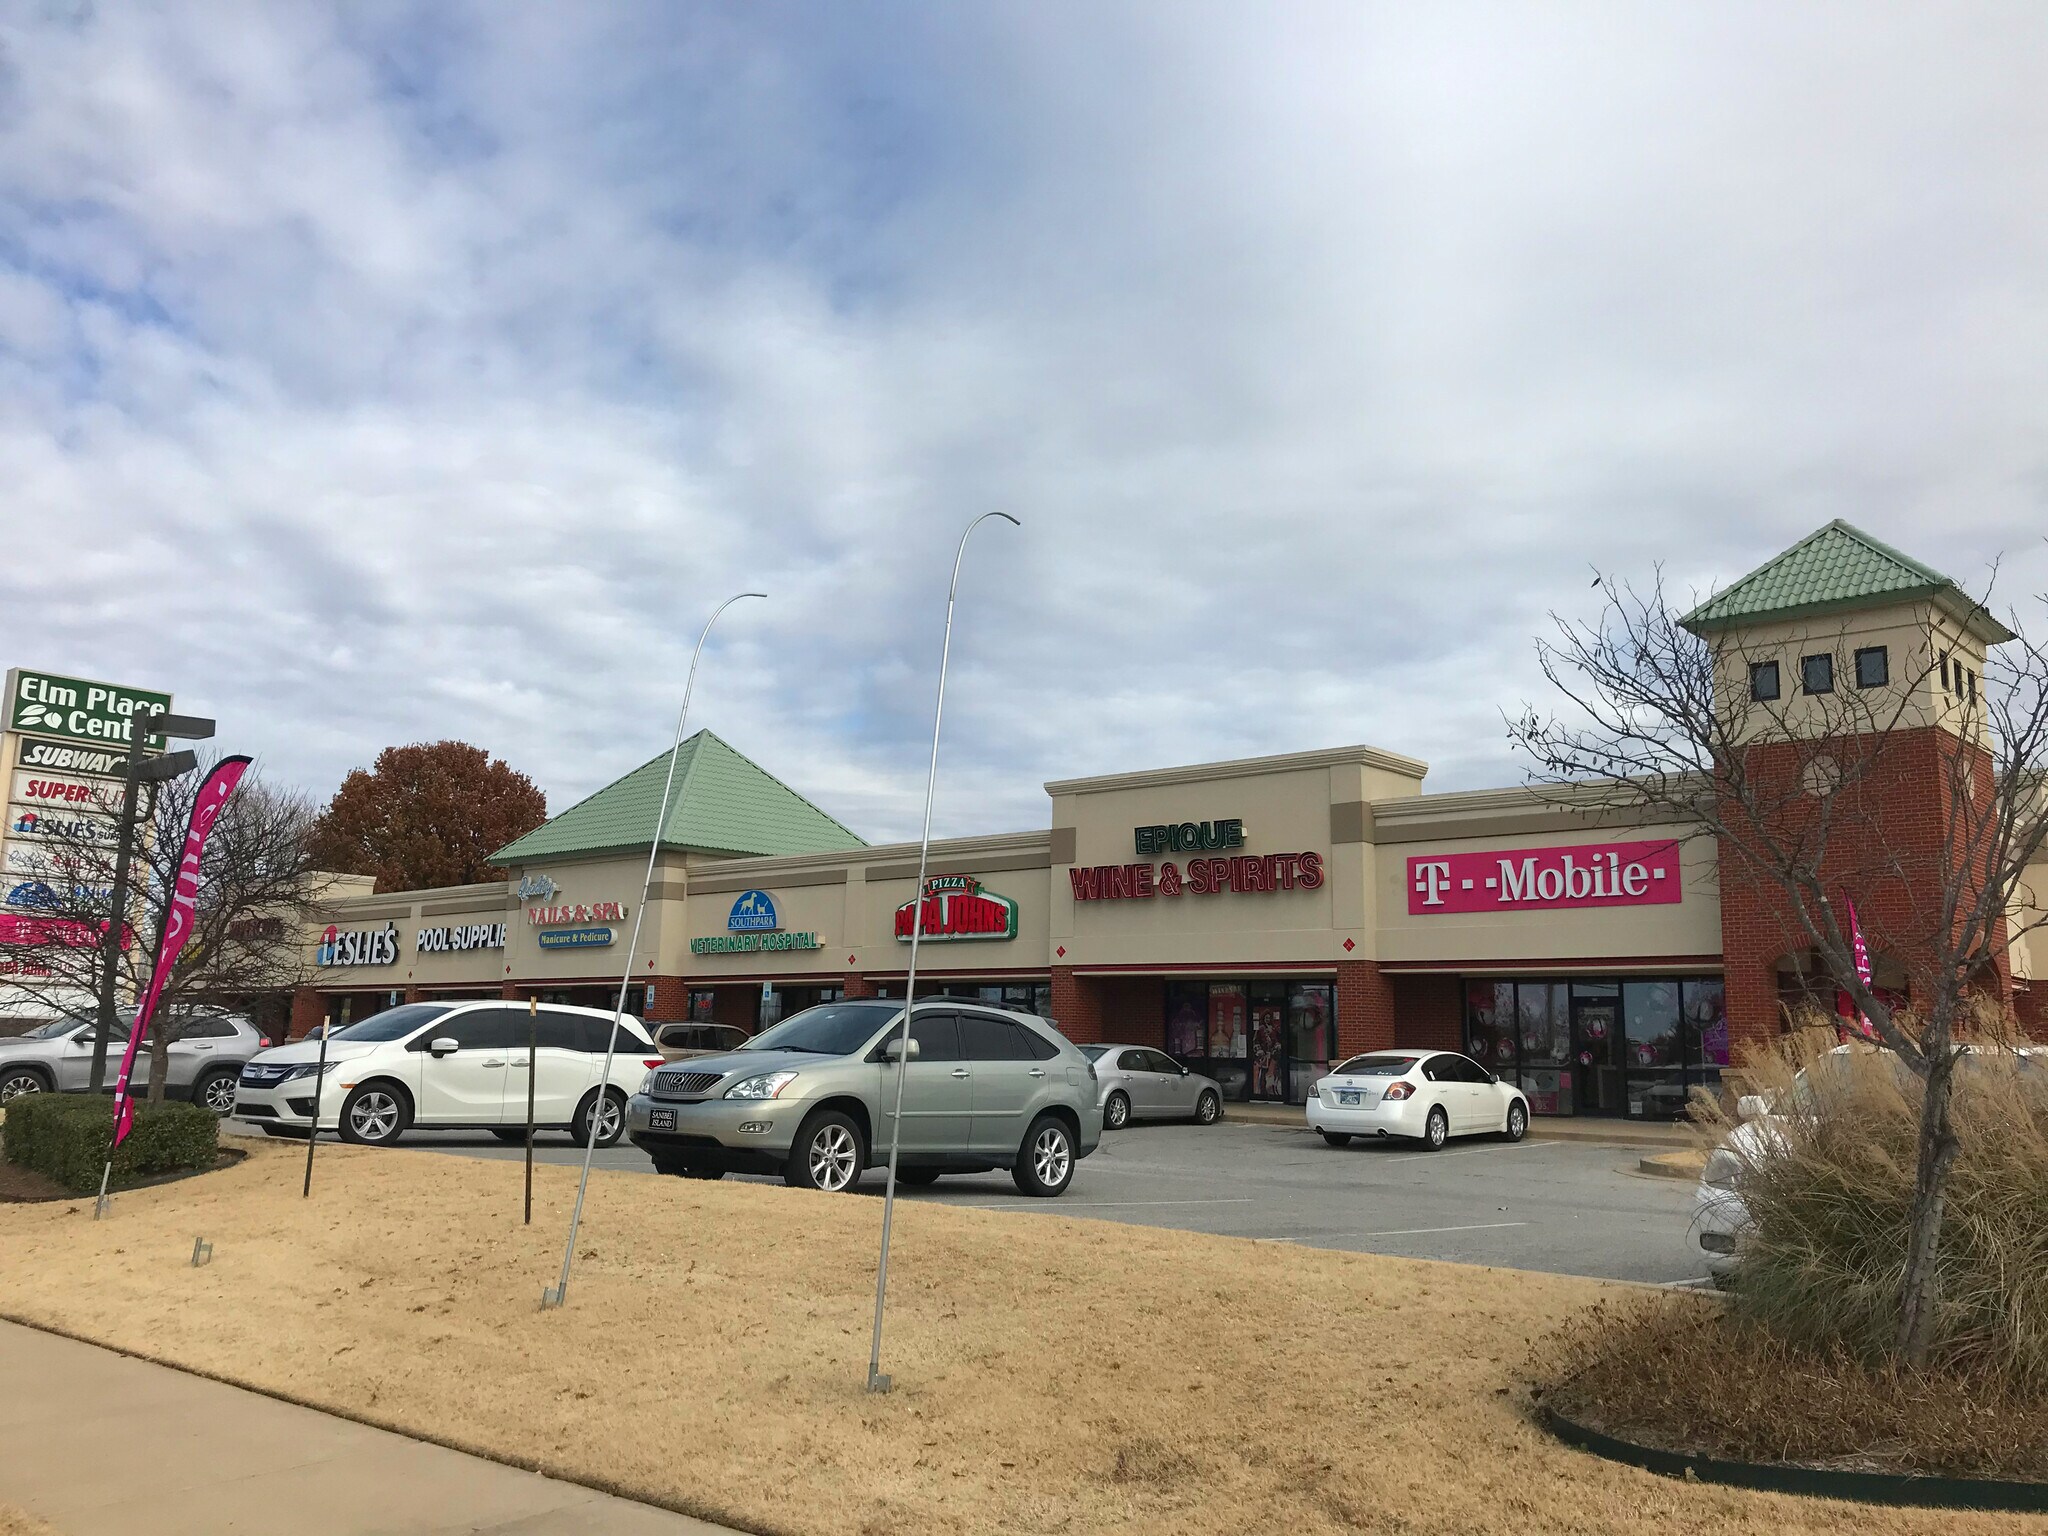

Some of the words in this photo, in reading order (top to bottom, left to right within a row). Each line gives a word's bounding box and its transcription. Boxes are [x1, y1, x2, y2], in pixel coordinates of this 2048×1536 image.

[20, 677, 76, 707] Elm
[87, 687, 165, 717] Place
[69, 710, 157, 744] Cent
[23, 745, 126, 773] SUBWAY
[1134, 819, 1244, 854] EPIQUE
[932, 877, 966, 890] PIZZA
[1069, 863, 1155, 901] WINE
[1159, 862, 1183, 896] &
[1187, 852, 1325, 894] SPIRITS
[528, 906, 571, 925] NAILS
[574, 904, 588, 923] &
[592, 902, 623, 921] SPA
[730, 915, 774, 928] SOUTHPARK
[895, 897, 942, 936] PAPA
[321, 921, 398, 966] LESLIE'S
[416, 928, 449, 951] POOL
[541, 934, 570, 945] Manicure
[572, 933, 578, 943] &
[580, 932, 609, 943] Pedicure
[690, 934, 760, 954] VETERINARY
[761, 932, 818, 951] HOSPITAL
